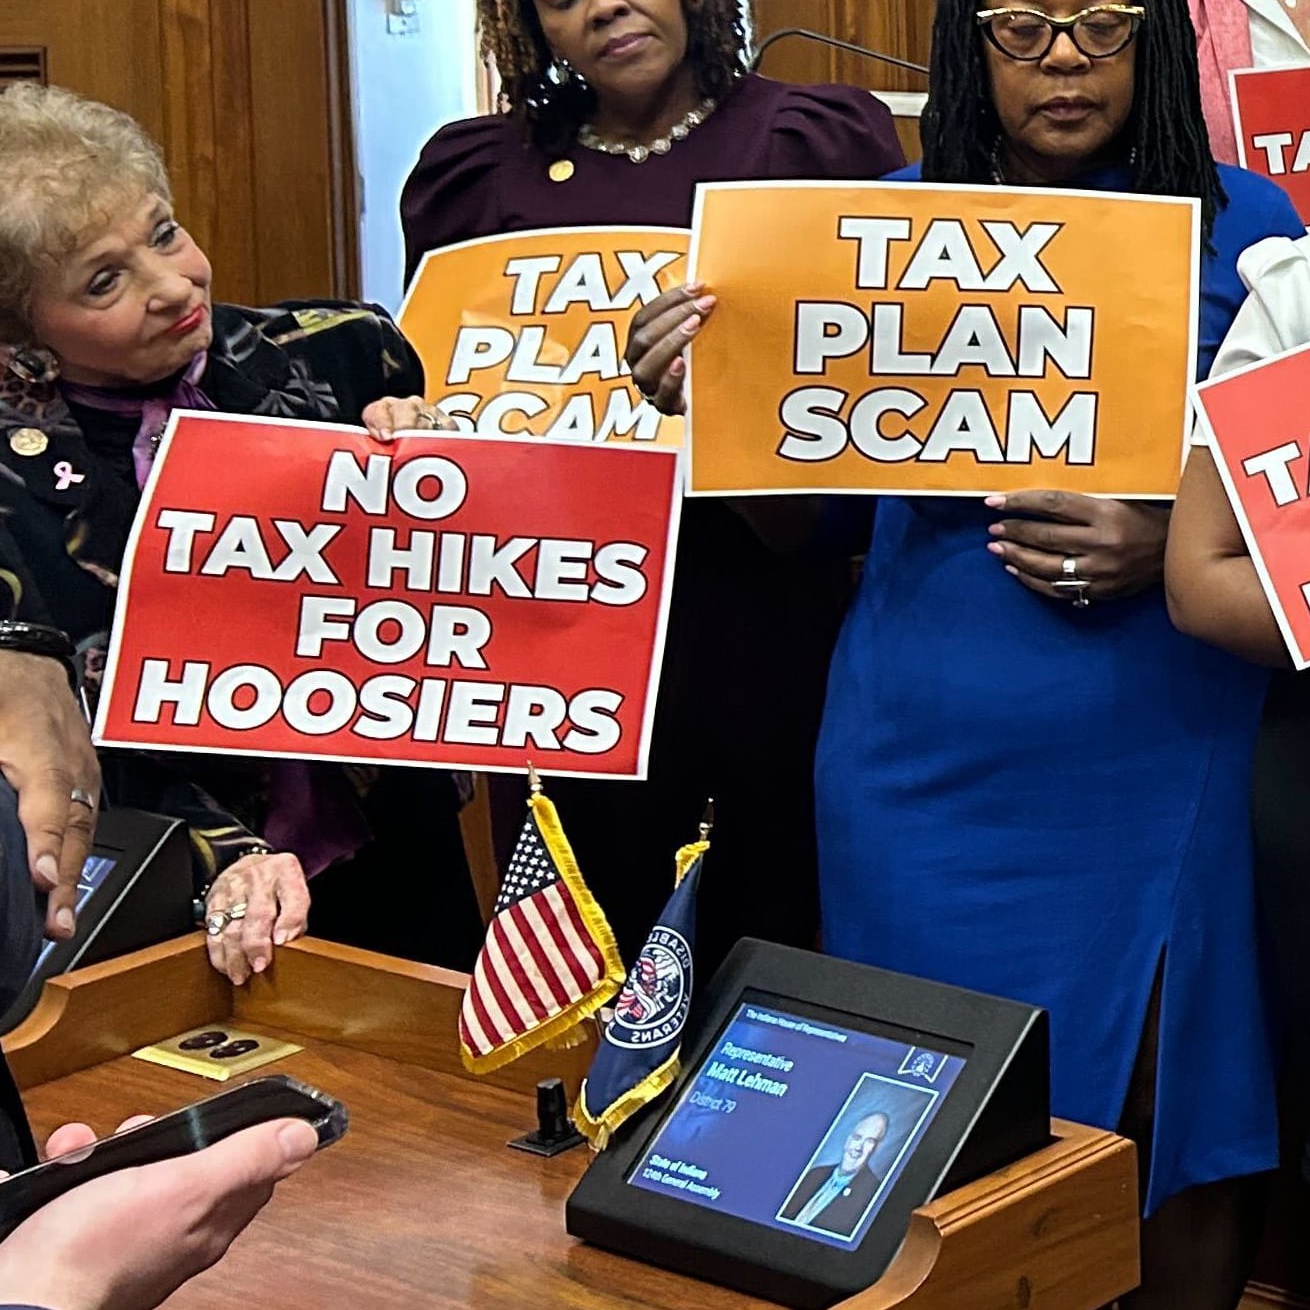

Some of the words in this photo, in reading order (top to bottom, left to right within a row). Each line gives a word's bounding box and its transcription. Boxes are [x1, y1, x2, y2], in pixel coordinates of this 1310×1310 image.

[503, 250, 686, 316] TAX
[837, 213, 1065, 295] TAX
[445, 320, 634, 387] PLA
[793, 300, 1096, 381] PLAN
[775, 386, 1100, 467] SCAM
[320, 447, 470, 523] NO
[155, 506, 344, 586] TAX
[365, 527, 650, 608] HIKES
[294, 593, 493, 672] FOR
[131, 656, 625, 756] HOOSIERS
[706, 1061, 736, 1083] Matt
[736, 1069, 789, 1098] Lehman
[720, 1041, 794, 1072] Representative
[689, 1090, 722, 1111] District
[720, 1099, 737, 1114] 79
